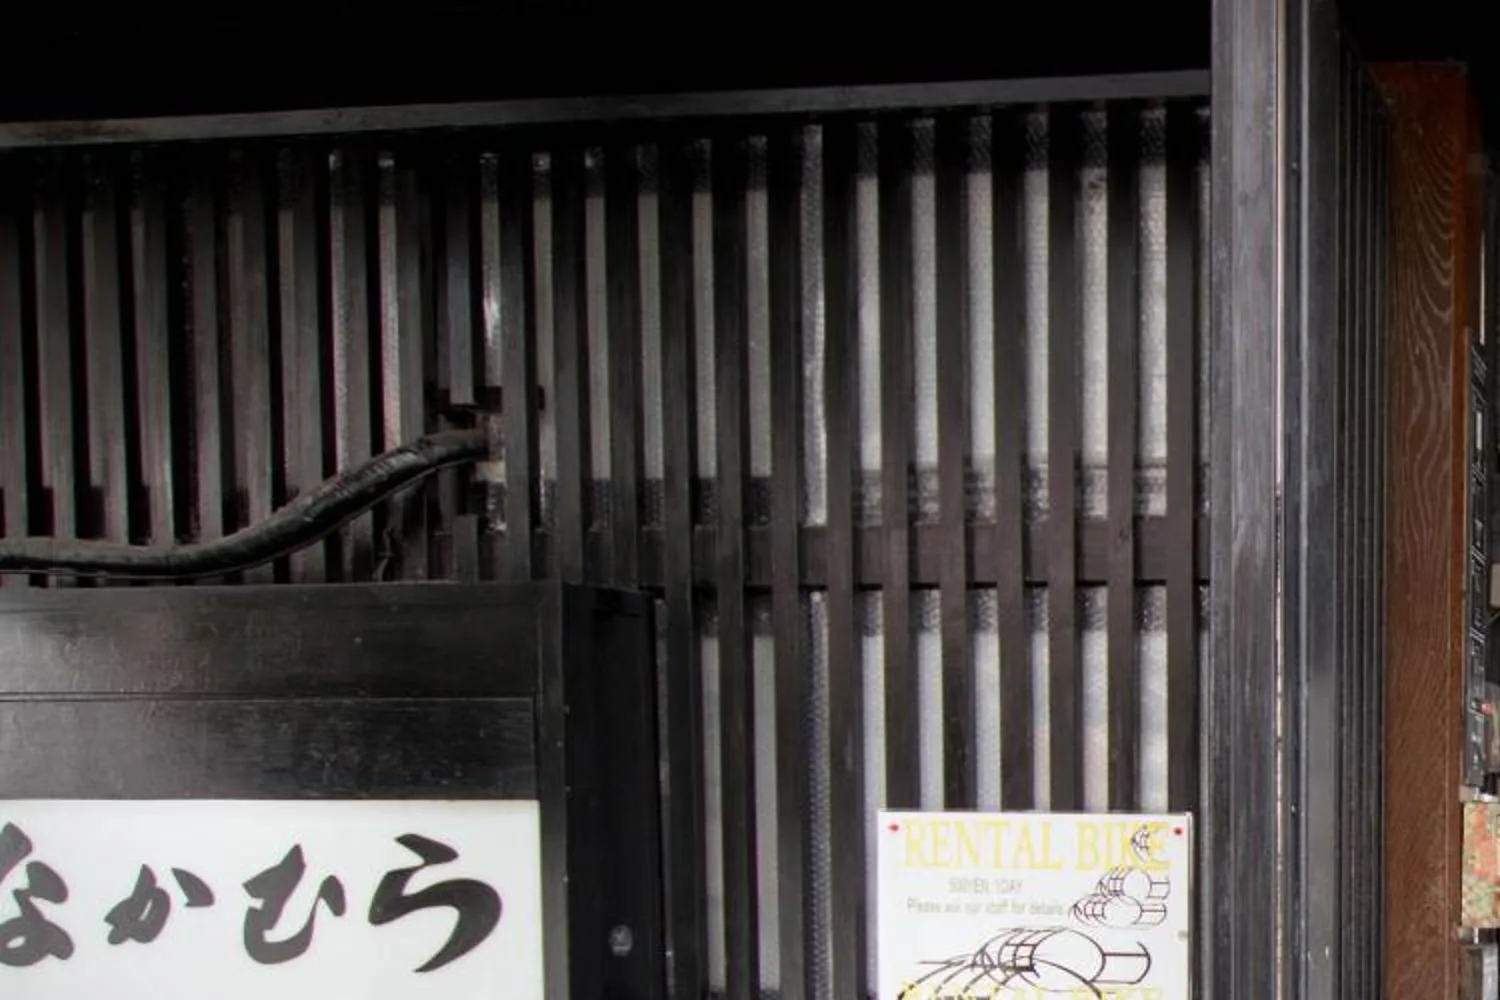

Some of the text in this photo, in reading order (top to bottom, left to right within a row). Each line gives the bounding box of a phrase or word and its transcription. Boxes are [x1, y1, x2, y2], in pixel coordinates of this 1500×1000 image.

[0, 822, 503, 973] なかむら
[903, 818, 1171, 874] RENTAL BIKE
